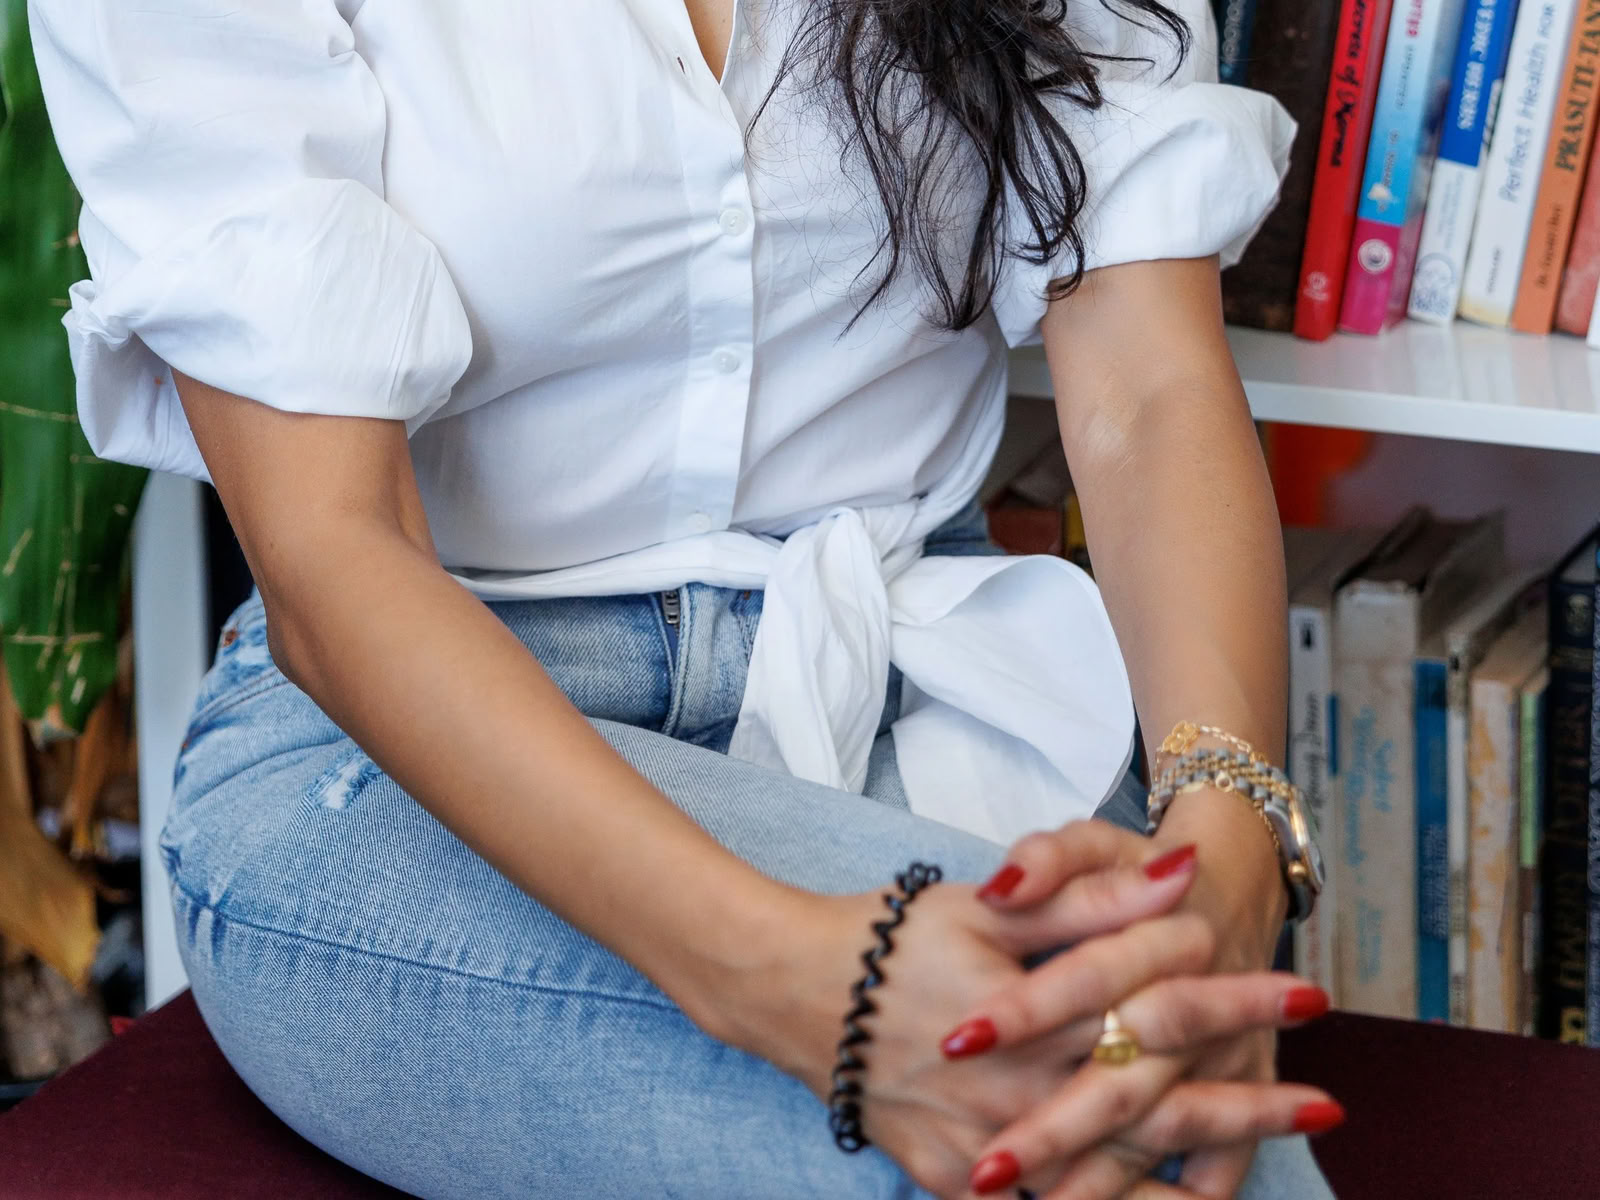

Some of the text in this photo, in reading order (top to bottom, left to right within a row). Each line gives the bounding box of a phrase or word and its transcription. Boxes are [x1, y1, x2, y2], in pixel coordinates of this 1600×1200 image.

[1337, 67, 1360, 88] of
[1501, 125, 1532, 203] Perfect
[1517, 41, 1548, 119] Health
